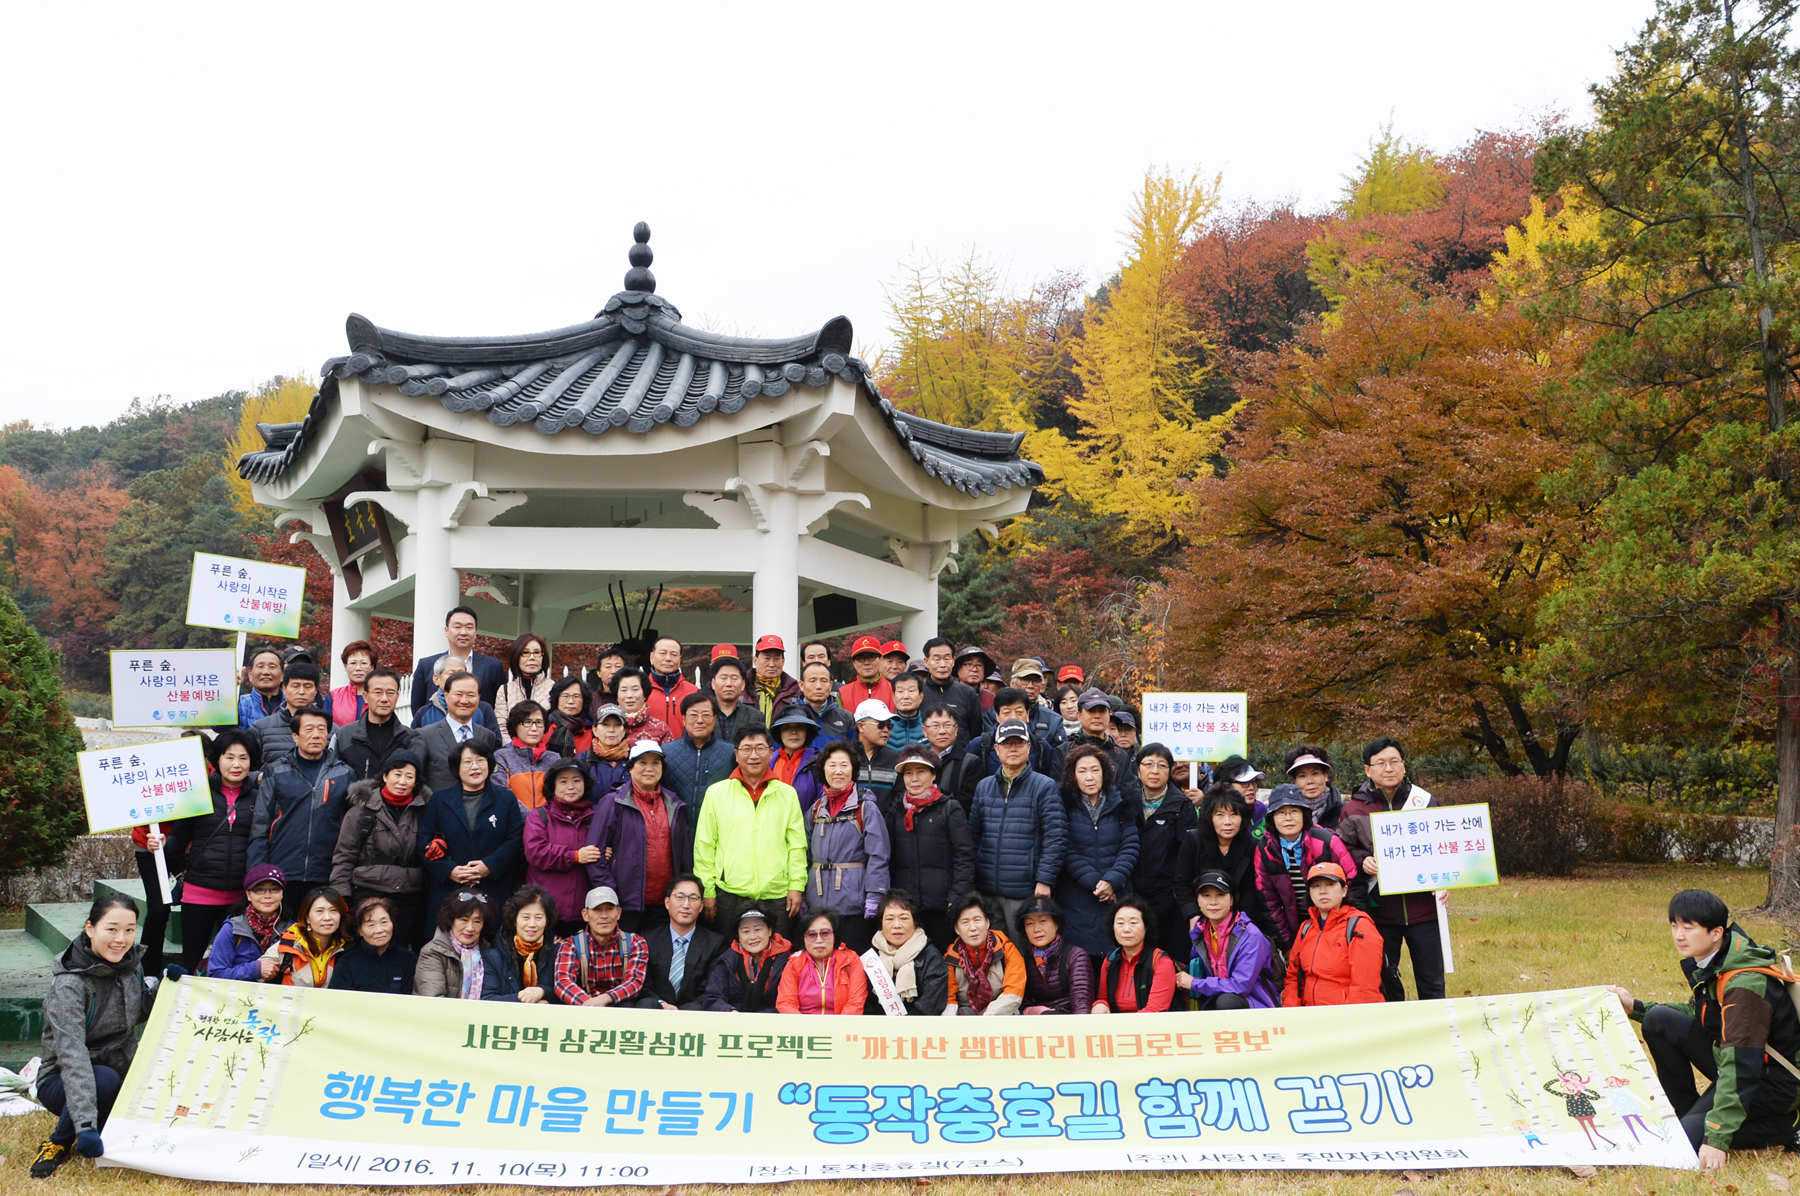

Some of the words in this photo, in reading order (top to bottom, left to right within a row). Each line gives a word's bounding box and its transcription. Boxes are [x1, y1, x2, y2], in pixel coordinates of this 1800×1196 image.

[210, 563, 232, 577] 푸른
[238, 568, 252, 580] 숲,
[217, 580, 251, 595] 사랑의
[256, 586, 288, 600] 시작은
[240, 597, 287, 614] 산불예방!
[237, 616, 265, 627] 동작구
[129, 660, 153, 672] 푸른
[160, 659, 176, 671] 숲,
[140, 675, 177, 687] 사랑의
[183, 674, 219, 686] 시작은
[167, 689, 220, 702] 산불예방!
[167, 710, 199, 720] 동작구
[1149, 702, 1168, 713] 내가
[1172, 702, 1192, 713] 좋아
[1196, 702, 1215, 713] 가는
[1220, 702, 1240, 713] 산에
[1149, 721, 1168, 732] 내가
[1172, 721, 1192, 732] 먼저
[1196, 721, 1215, 732] 산불
[1219, 721, 1239, 733] 조심
[1186, 746, 1213, 755] 동작구
[98, 756, 123, 771] 푸른
[129, 754, 146, 767] 숲,
[112, 769, 149, 785] 사랑의
[154, 763, 189, 779] 시작은
[141, 778, 193, 798] 산불예방!
[144, 803, 175, 816] 동작구
[1380, 823, 1403, 836] 내가
[1407, 821, 1430, 835] 좋아
[1434, 819, 1456, 832] 가는
[1461, 816, 1483, 830] 산에
[1383, 846, 1406, 859] 내가
[1410, 843, 1433, 857] 먼저
[1437, 841, 1459, 855] 산불
[1464, 838, 1486, 852] 조심
[1430, 871, 1460, 883] 동작구
[461, 1024, 549, 1052] 사당역
[559, 1029, 706, 1058] 상권활성화
[717, 1034, 832, 1060] 프로젝트
[845, 1034, 948, 1060] "까치산
[959, 1035, 1076, 1060] 생태다리
[1085, 1031, 1204, 1058] 데크로드
[319, 1071, 476, 1128] 행복한
[486, 1084, 589, 1134] 마을
[604, 1089, 755, 1137] 만들기
[1135, 1077, 1270, 1139] 함께
[1200, 1153, 1286, 1163] 사당1동
[1296, 1149, 1469, 1162] 주민자치위원회
[368, 1157, 433, 1175] 2016.
[451, 1161, 482, 1177] 11.
[498, 1162, 567, 1178] 10(목)
[580, 1165, 649, 1178] 11:00
[819, 1157, 1024, 1174] 동작충효길(7코스)
